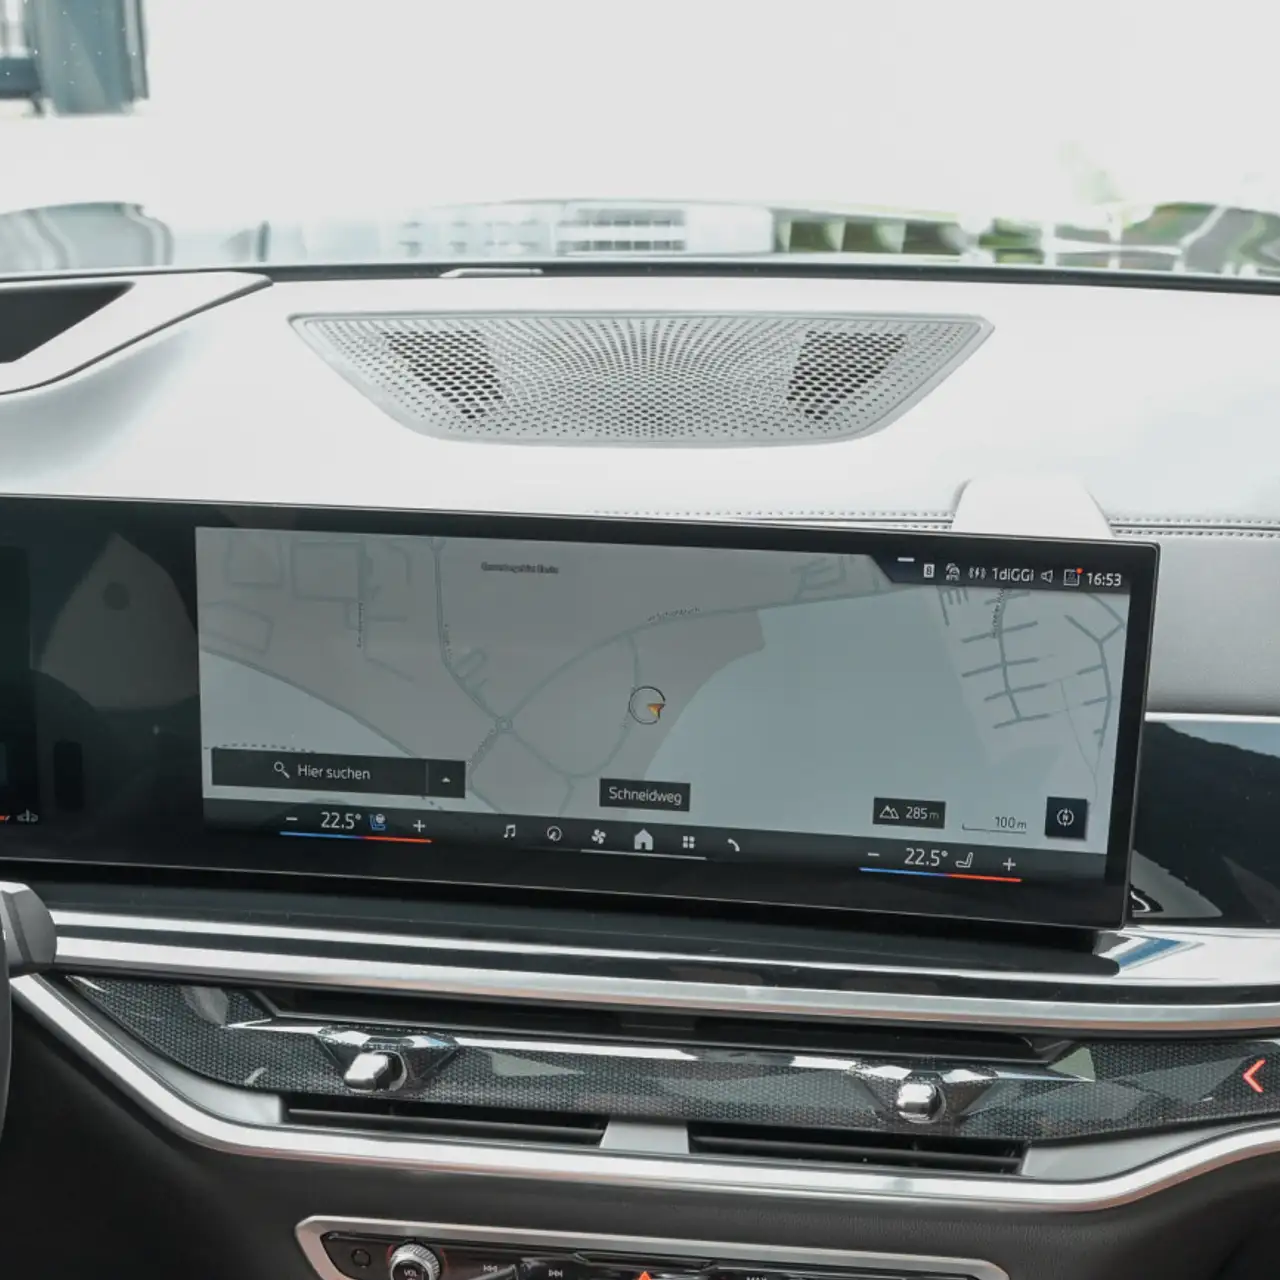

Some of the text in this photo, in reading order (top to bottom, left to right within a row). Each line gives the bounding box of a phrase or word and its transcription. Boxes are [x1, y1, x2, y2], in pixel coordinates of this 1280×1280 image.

[1087, 572, 1123, 587] 16:53
[297, 763, 371, 781] Hier suchen
[608, 785, 683, 807] Schneidweg
[905, 805, 928, 820] 285
[994, 816, 1017, 829] 100
[403, 1268, 418, 1278] VOL
